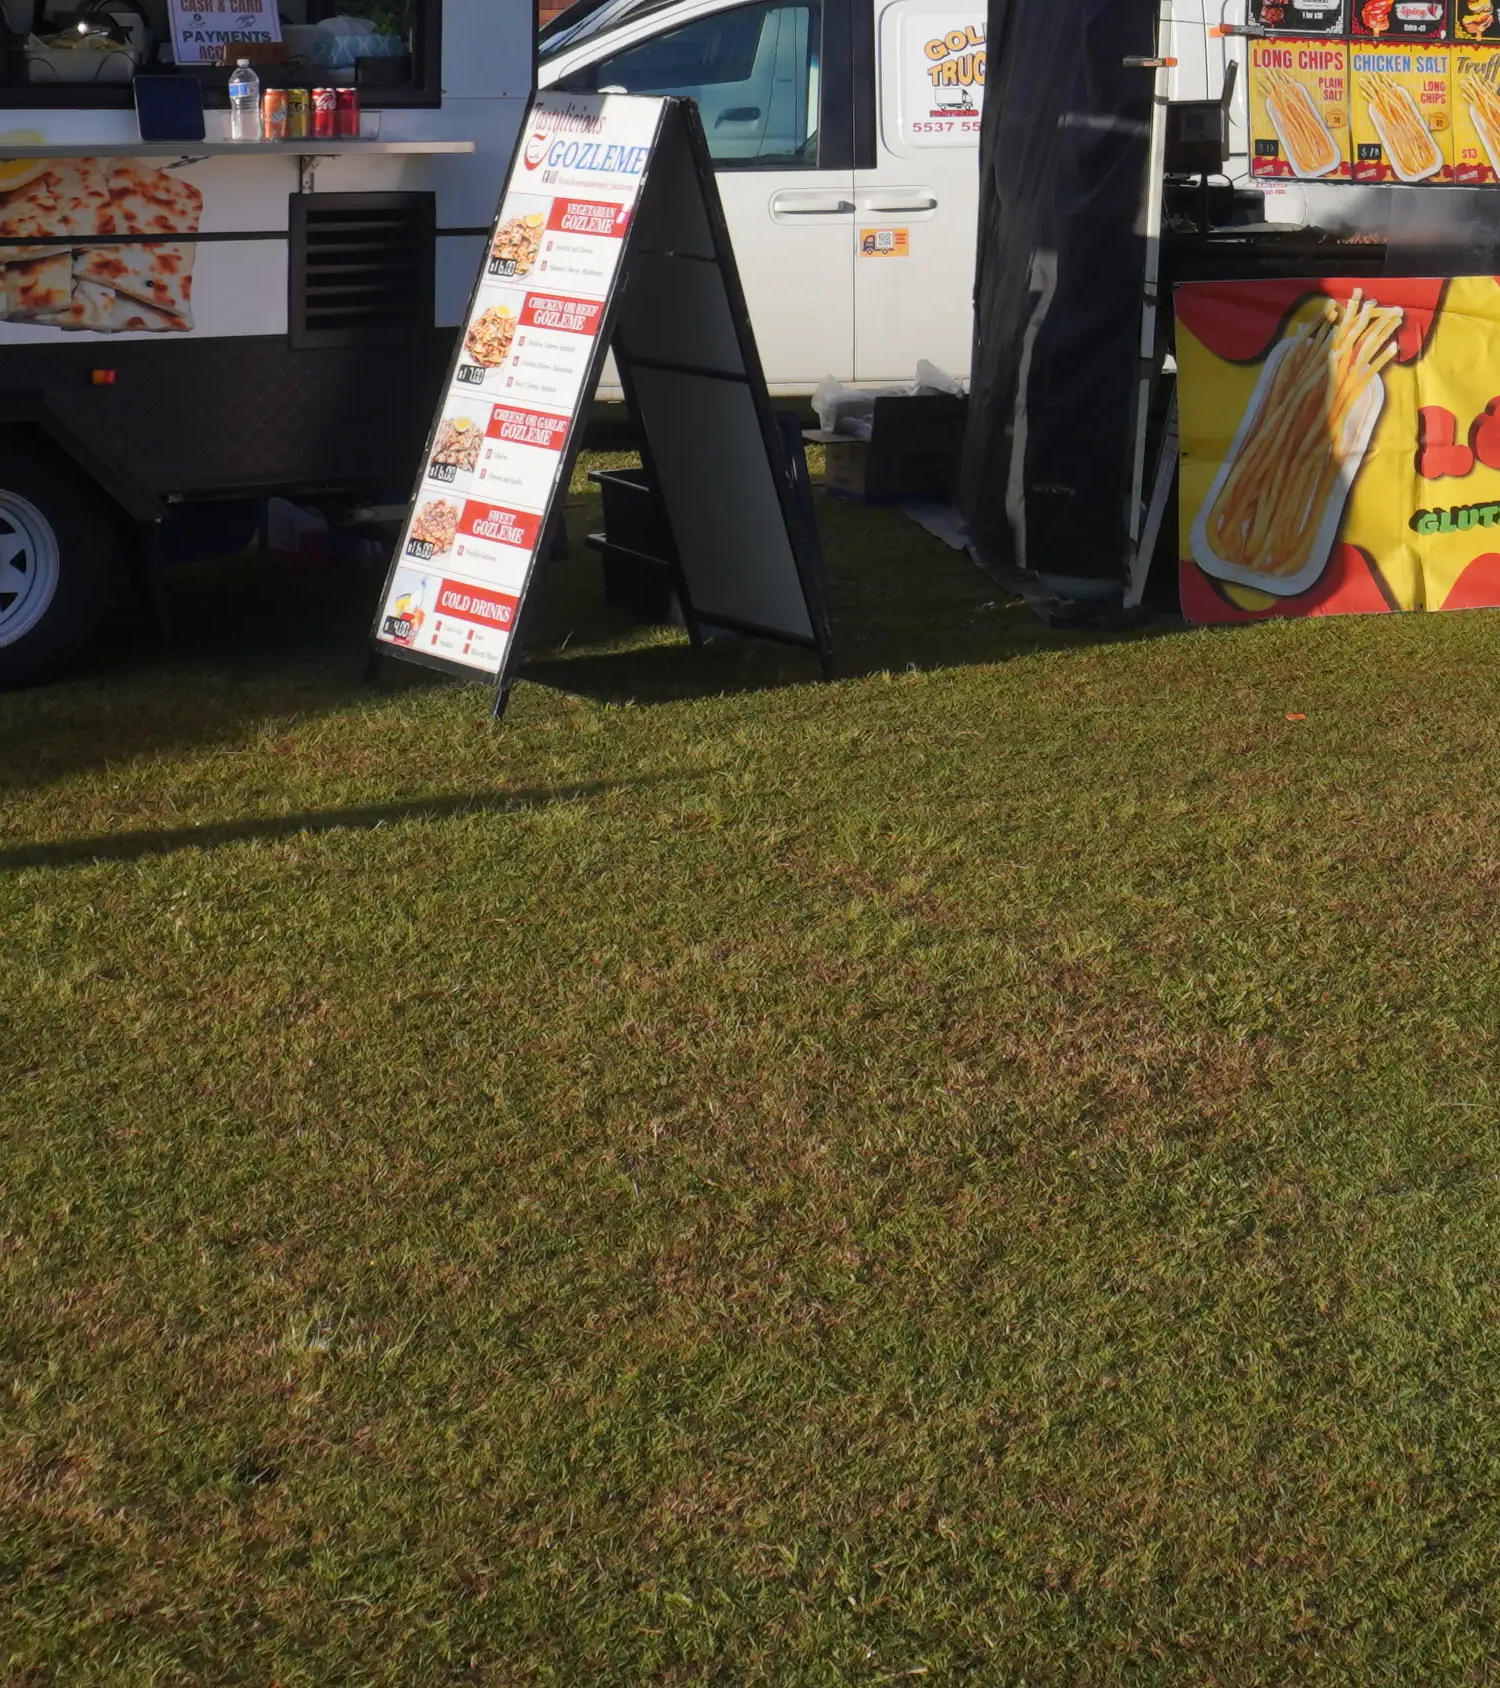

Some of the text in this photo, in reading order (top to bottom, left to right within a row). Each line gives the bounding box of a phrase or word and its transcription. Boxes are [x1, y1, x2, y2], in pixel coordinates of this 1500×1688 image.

[217, 0, 226, 12] &
[230, 0, 263, 13] CARD
[182, 30, 272, 43] PAYMENTS
[1253, 49, 1344, 71] LONG CHIPS
[1353, 55, 1447, 73] CHICKEN SALT
[927, 50, 987, 87] TRUC
[1318, 77, 1343, 89] PLAIN
[1423, 81, 1445, 92] LONG
[1323, 90, 1343, 101] SALT
[1420, 93, 1446, 104] CHIPS
[912, 122, 954, 133] 5537
[547, 140, 652, 175] GOZLEME
[561, 215, 614, 233] GOZLEME
[528, 297, 563, 312] CHICKEN
[533, 310, 586, 330] GOZLEME
[493, 409, 525, 424] CHEESE
[501, 422, 553, 445] GOZLEME
[487, 510, 517, 525] SWEET
[472, 519, 524, 544] GOZLEME
[441, 591, 511, 622] COLD DRINKS
